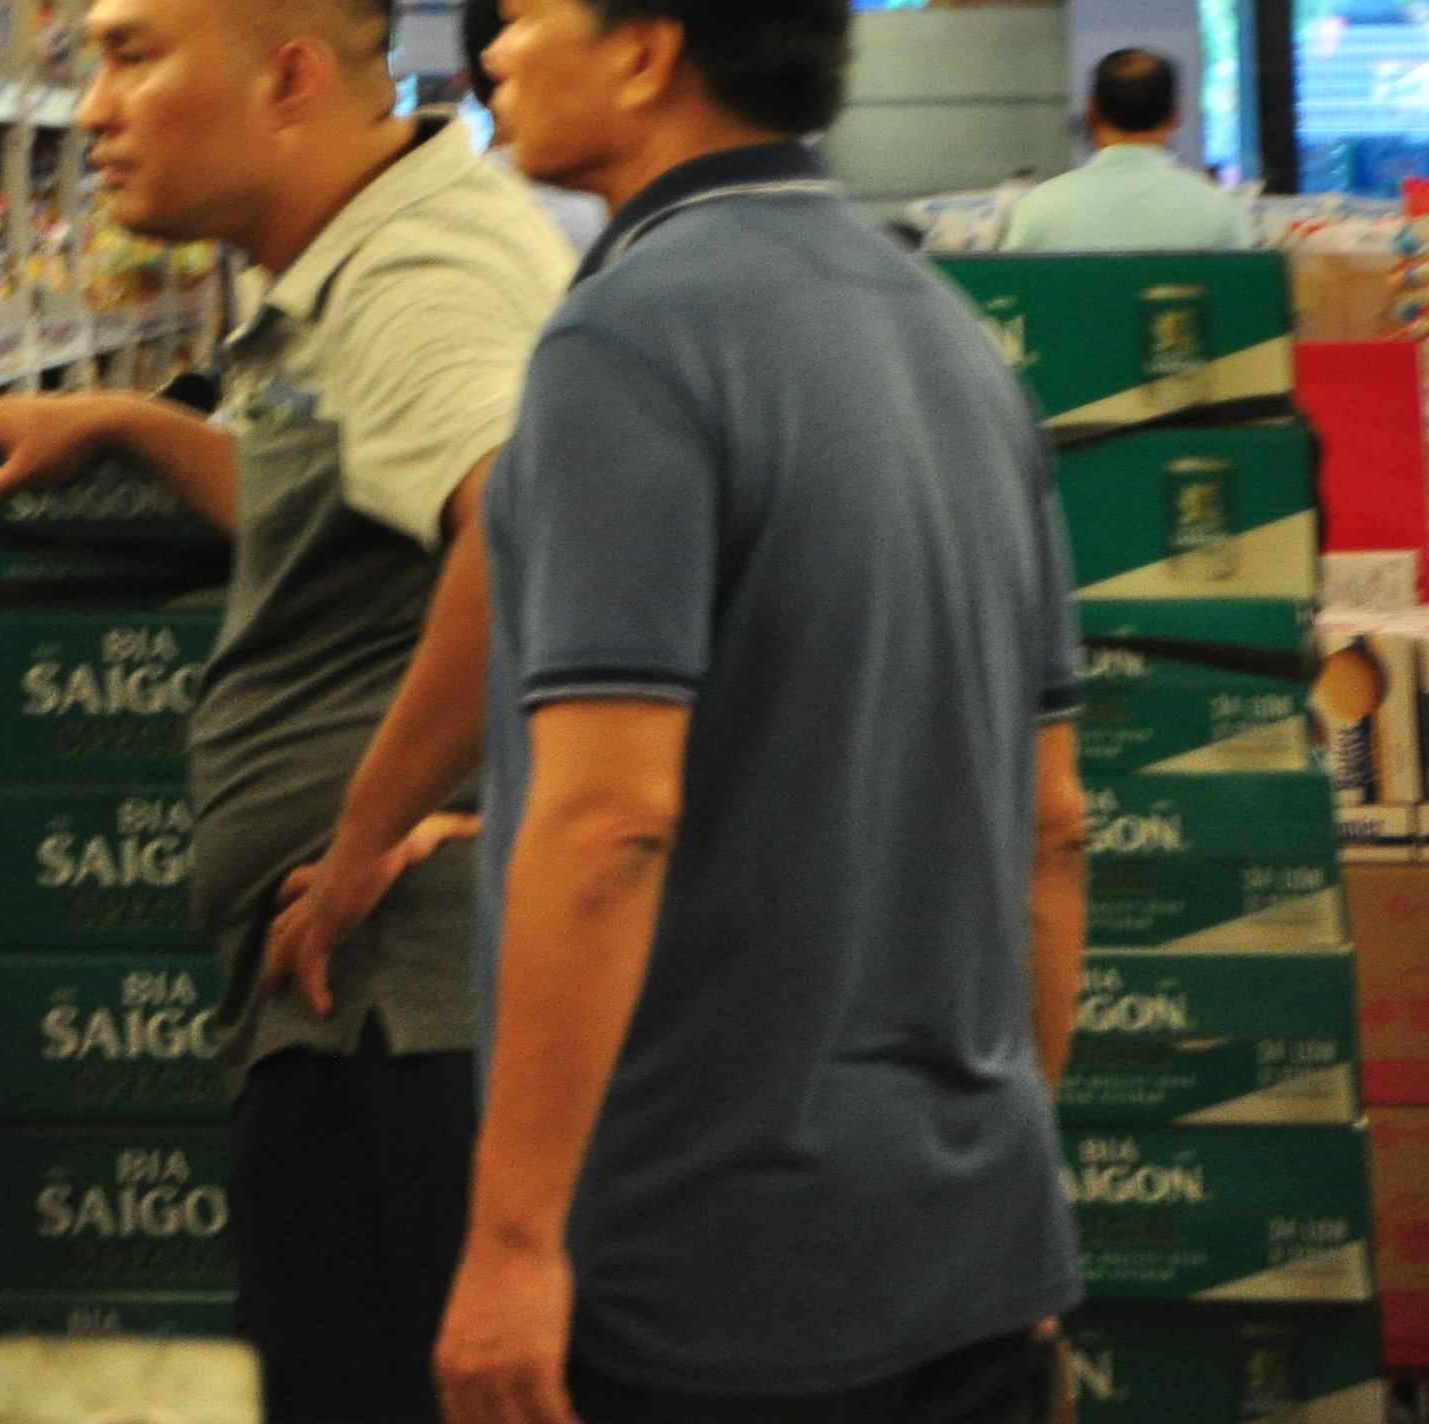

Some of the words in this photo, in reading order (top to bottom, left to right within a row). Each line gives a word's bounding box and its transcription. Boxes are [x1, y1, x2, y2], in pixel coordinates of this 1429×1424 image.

[21, 662, 203, 716] SAIGO
[36, 832, 193, 887] SAIG
[42, 1007, 221, 1060] SAIGO
[36, 1185, 230, 1239] SAIGO
